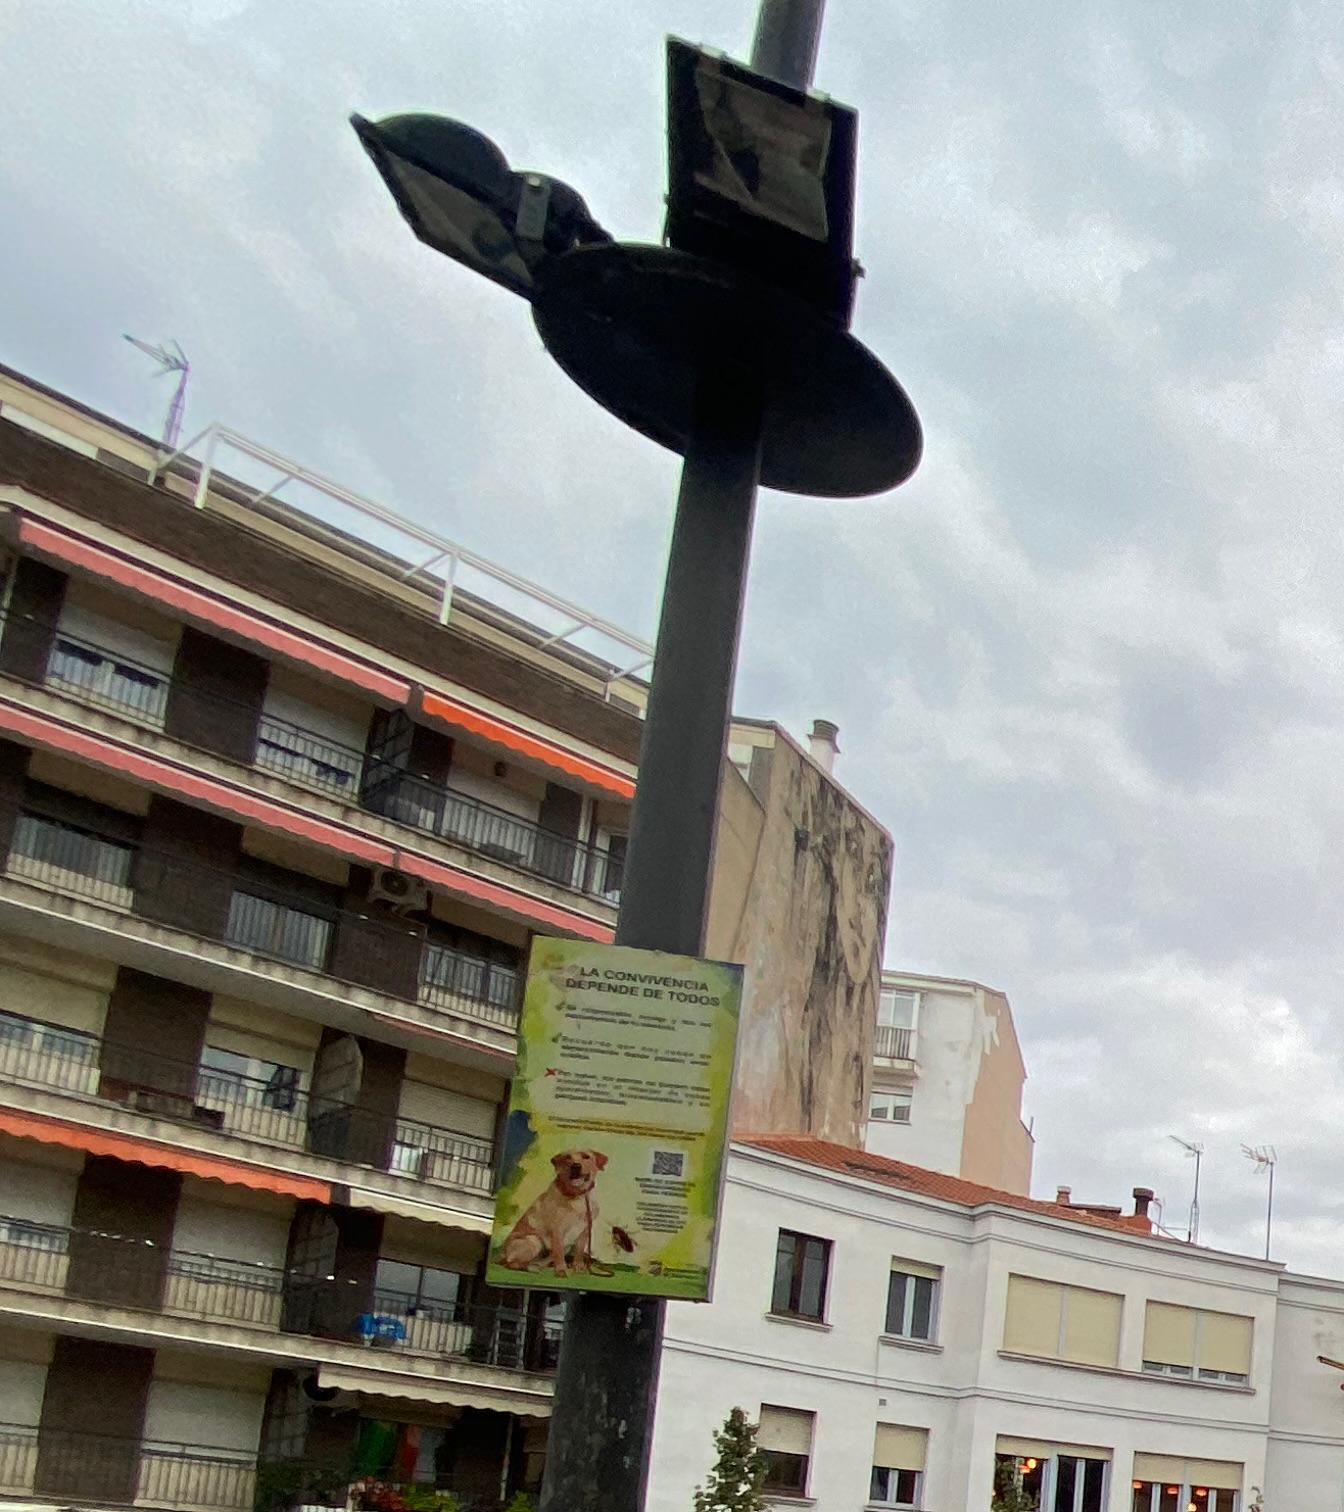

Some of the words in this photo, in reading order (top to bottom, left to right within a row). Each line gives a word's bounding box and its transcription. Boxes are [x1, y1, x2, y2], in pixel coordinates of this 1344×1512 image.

[565, 978, 639, 997] DEPENDE
[643, 988, 663, 1000] DE
[668, 990, 721, 1007] TODOS
[580, 966, 600, 978] LA
[604, 969, 709, 992] CONVIVENCIA
